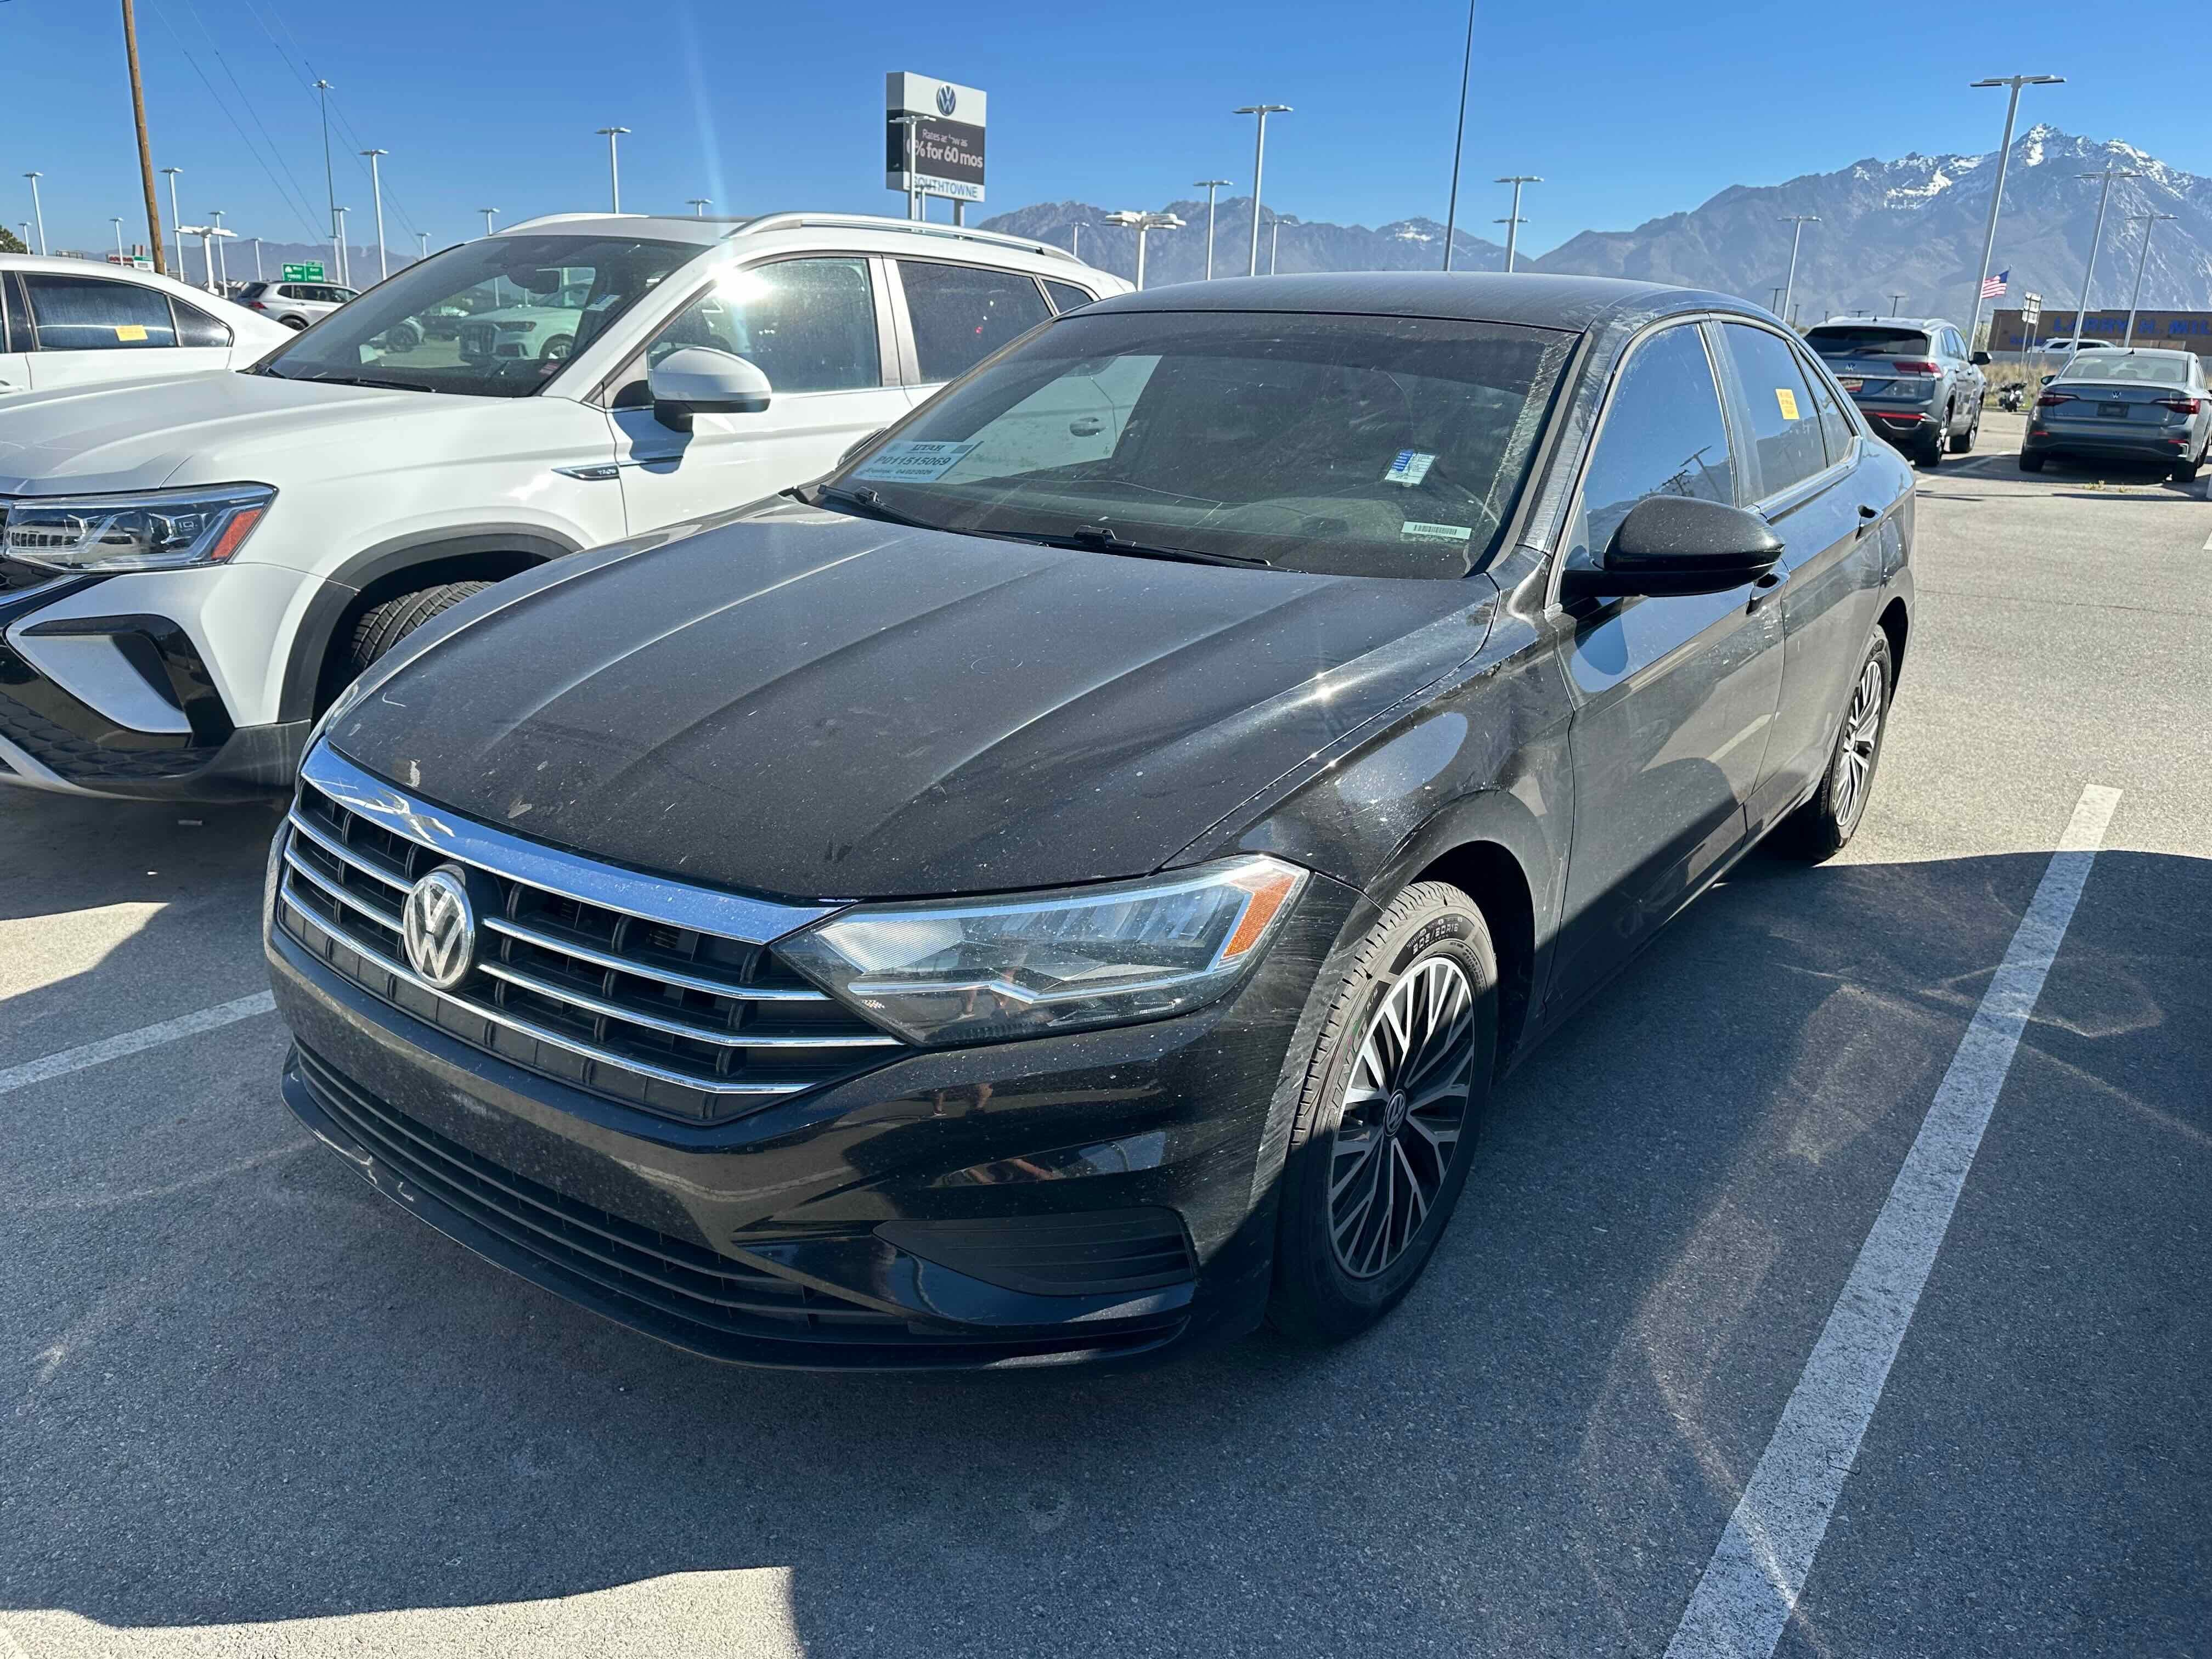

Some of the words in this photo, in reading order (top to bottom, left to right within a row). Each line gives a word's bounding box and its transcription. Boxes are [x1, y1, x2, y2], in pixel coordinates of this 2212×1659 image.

[926, 142, 944, 160] for
[944, 145, 958, 163] 60
[960, 153, 983, 168] mos
